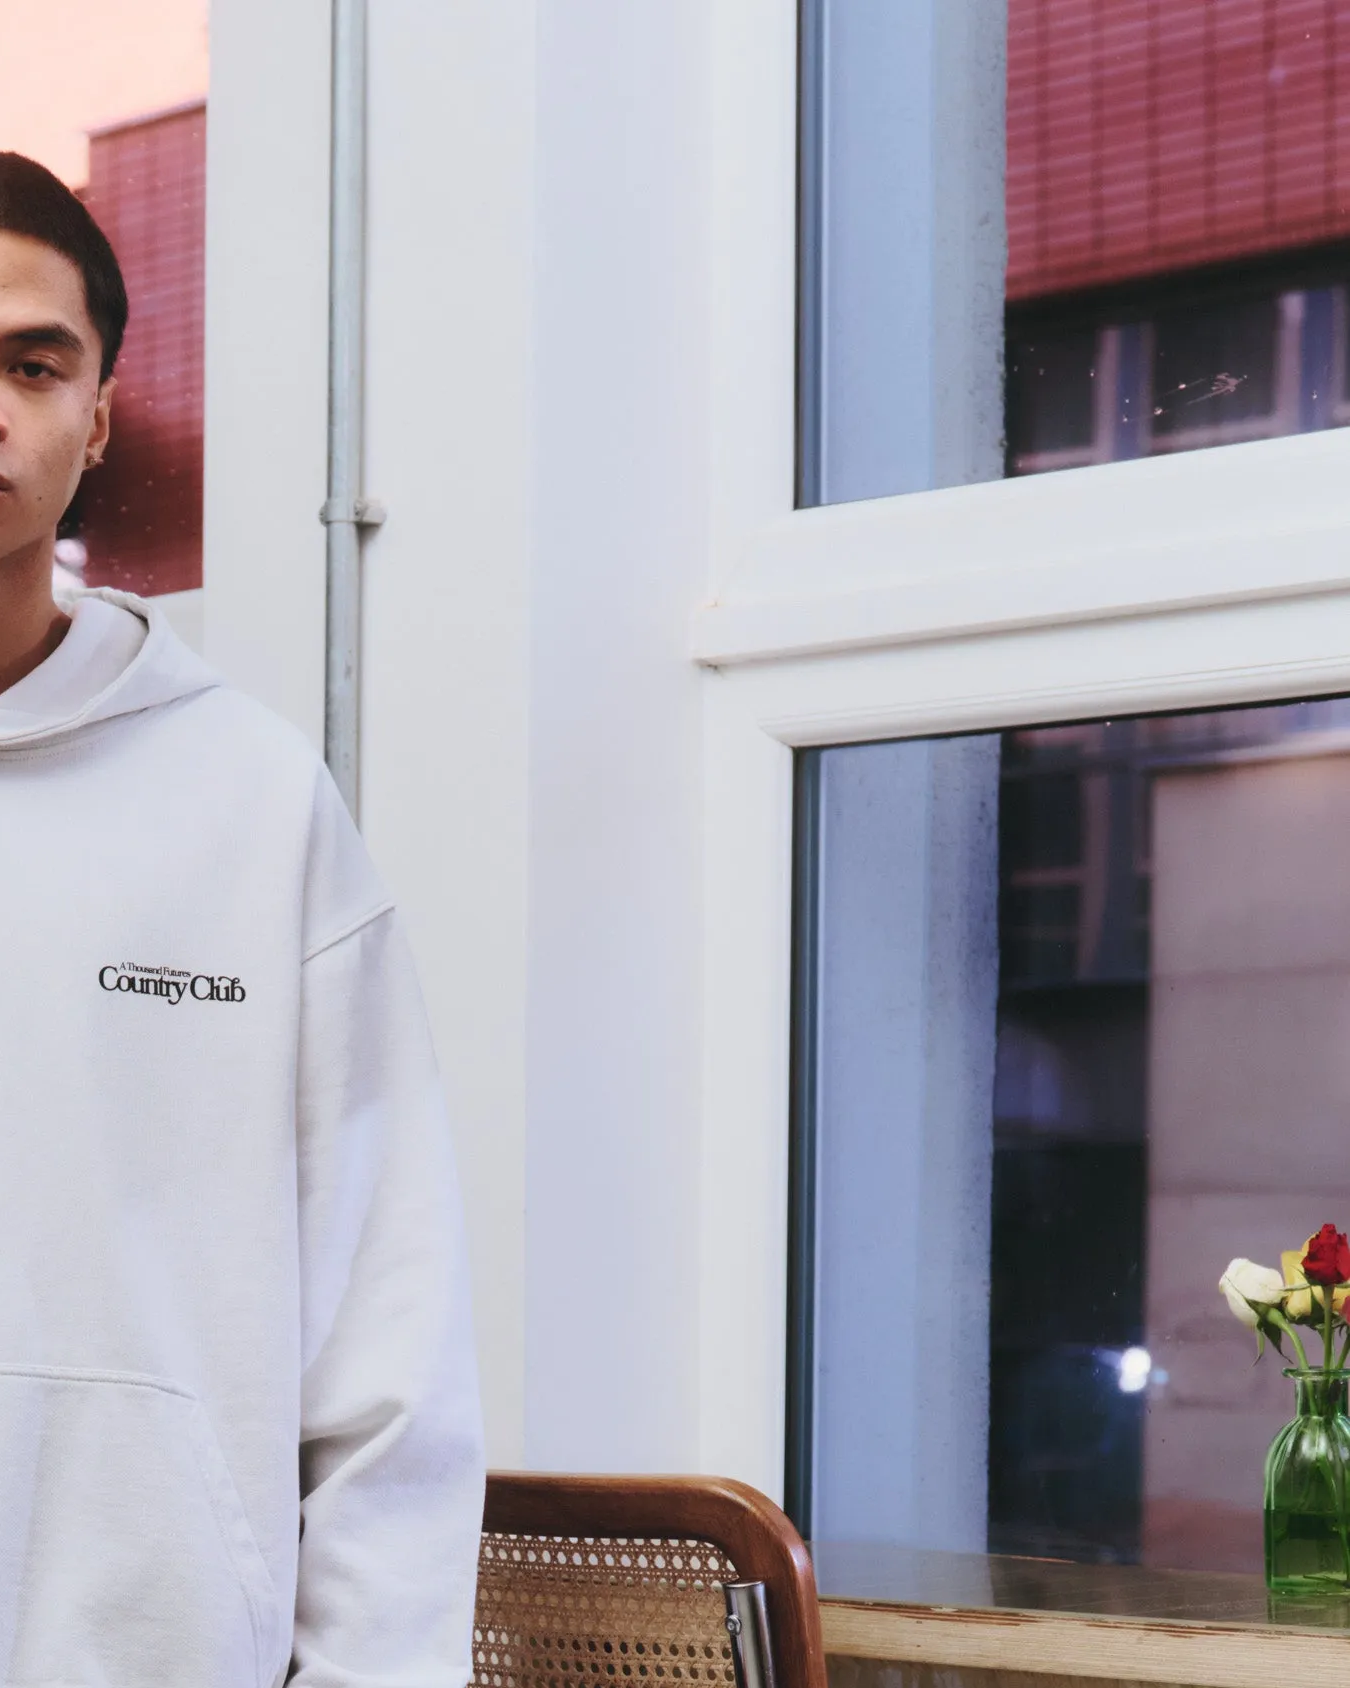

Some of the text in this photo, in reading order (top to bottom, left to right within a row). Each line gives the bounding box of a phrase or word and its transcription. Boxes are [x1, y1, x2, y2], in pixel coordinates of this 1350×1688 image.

[119, 962, 191, 978] A Thousand Futures
[98, 966, 246, 1005] Country Club
